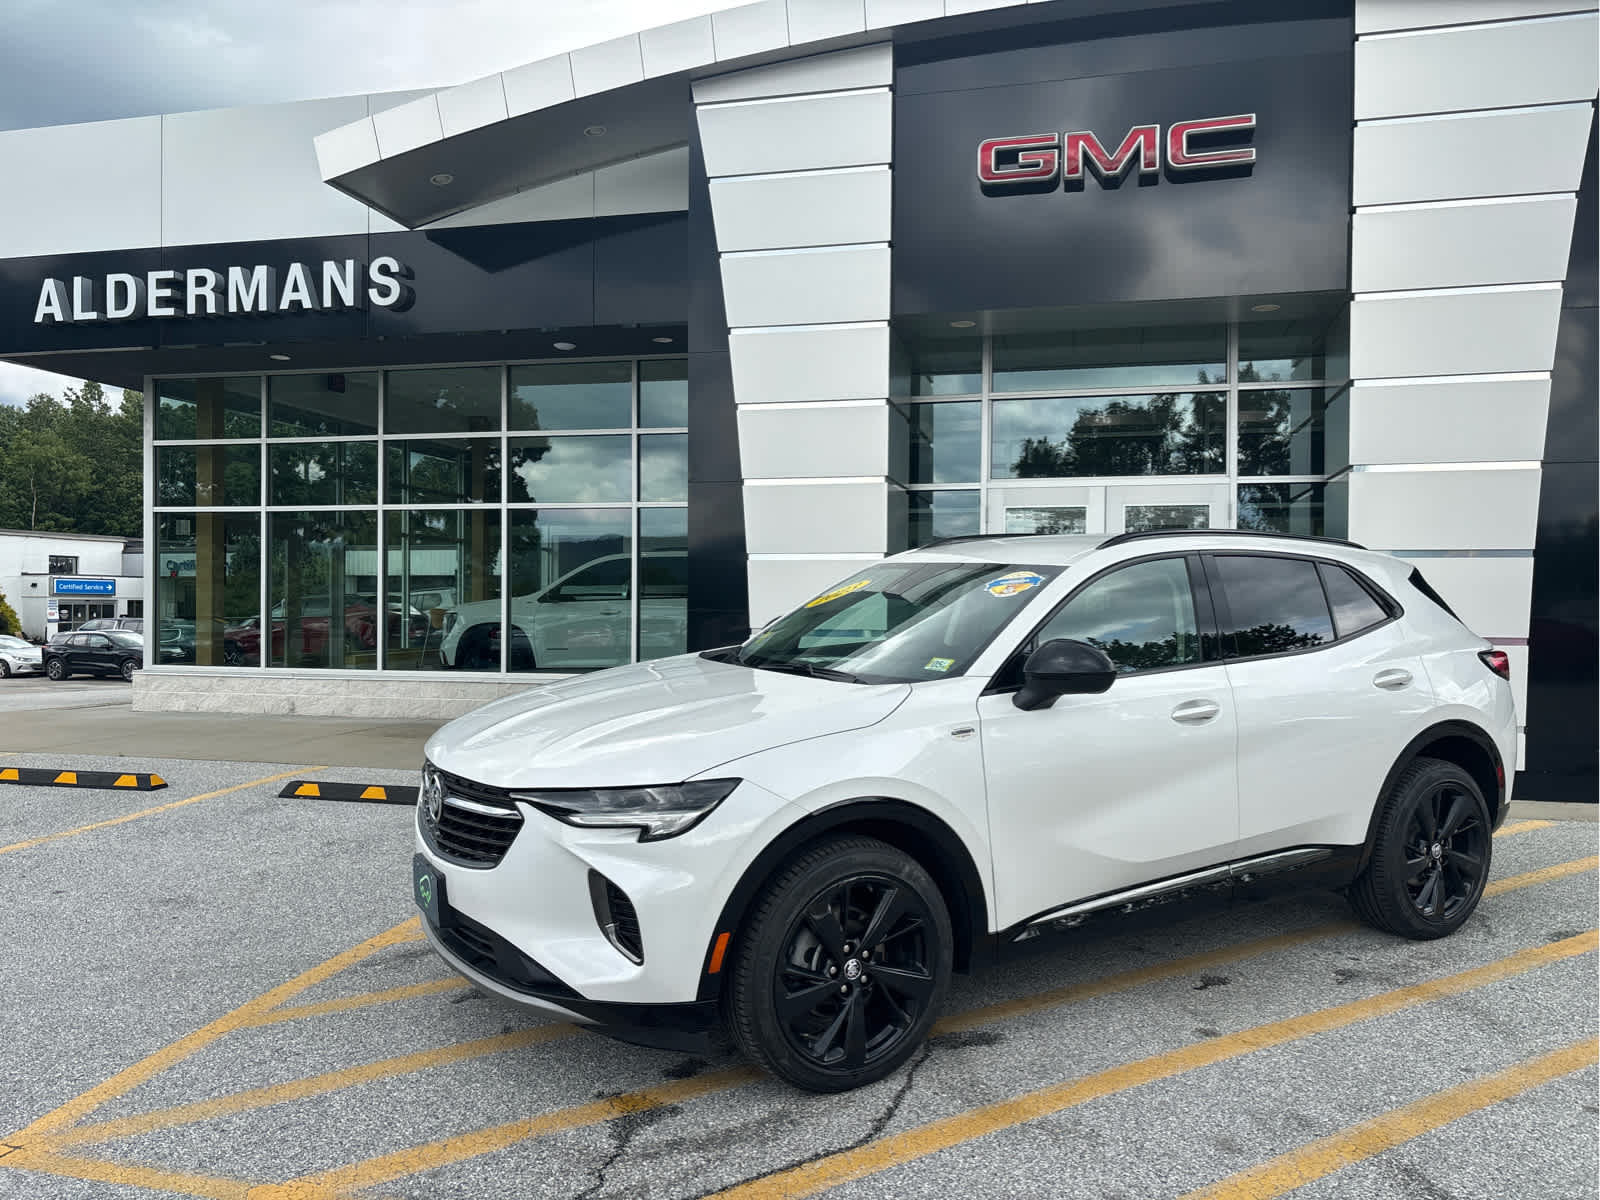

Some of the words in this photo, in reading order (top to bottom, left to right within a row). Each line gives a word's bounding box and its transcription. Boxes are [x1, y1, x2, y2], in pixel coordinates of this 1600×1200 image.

[977, 112, 1256, 186] GMC
[33, 256, 403, 325] ALDERMANS
[84, 583, 104, 591] Service
